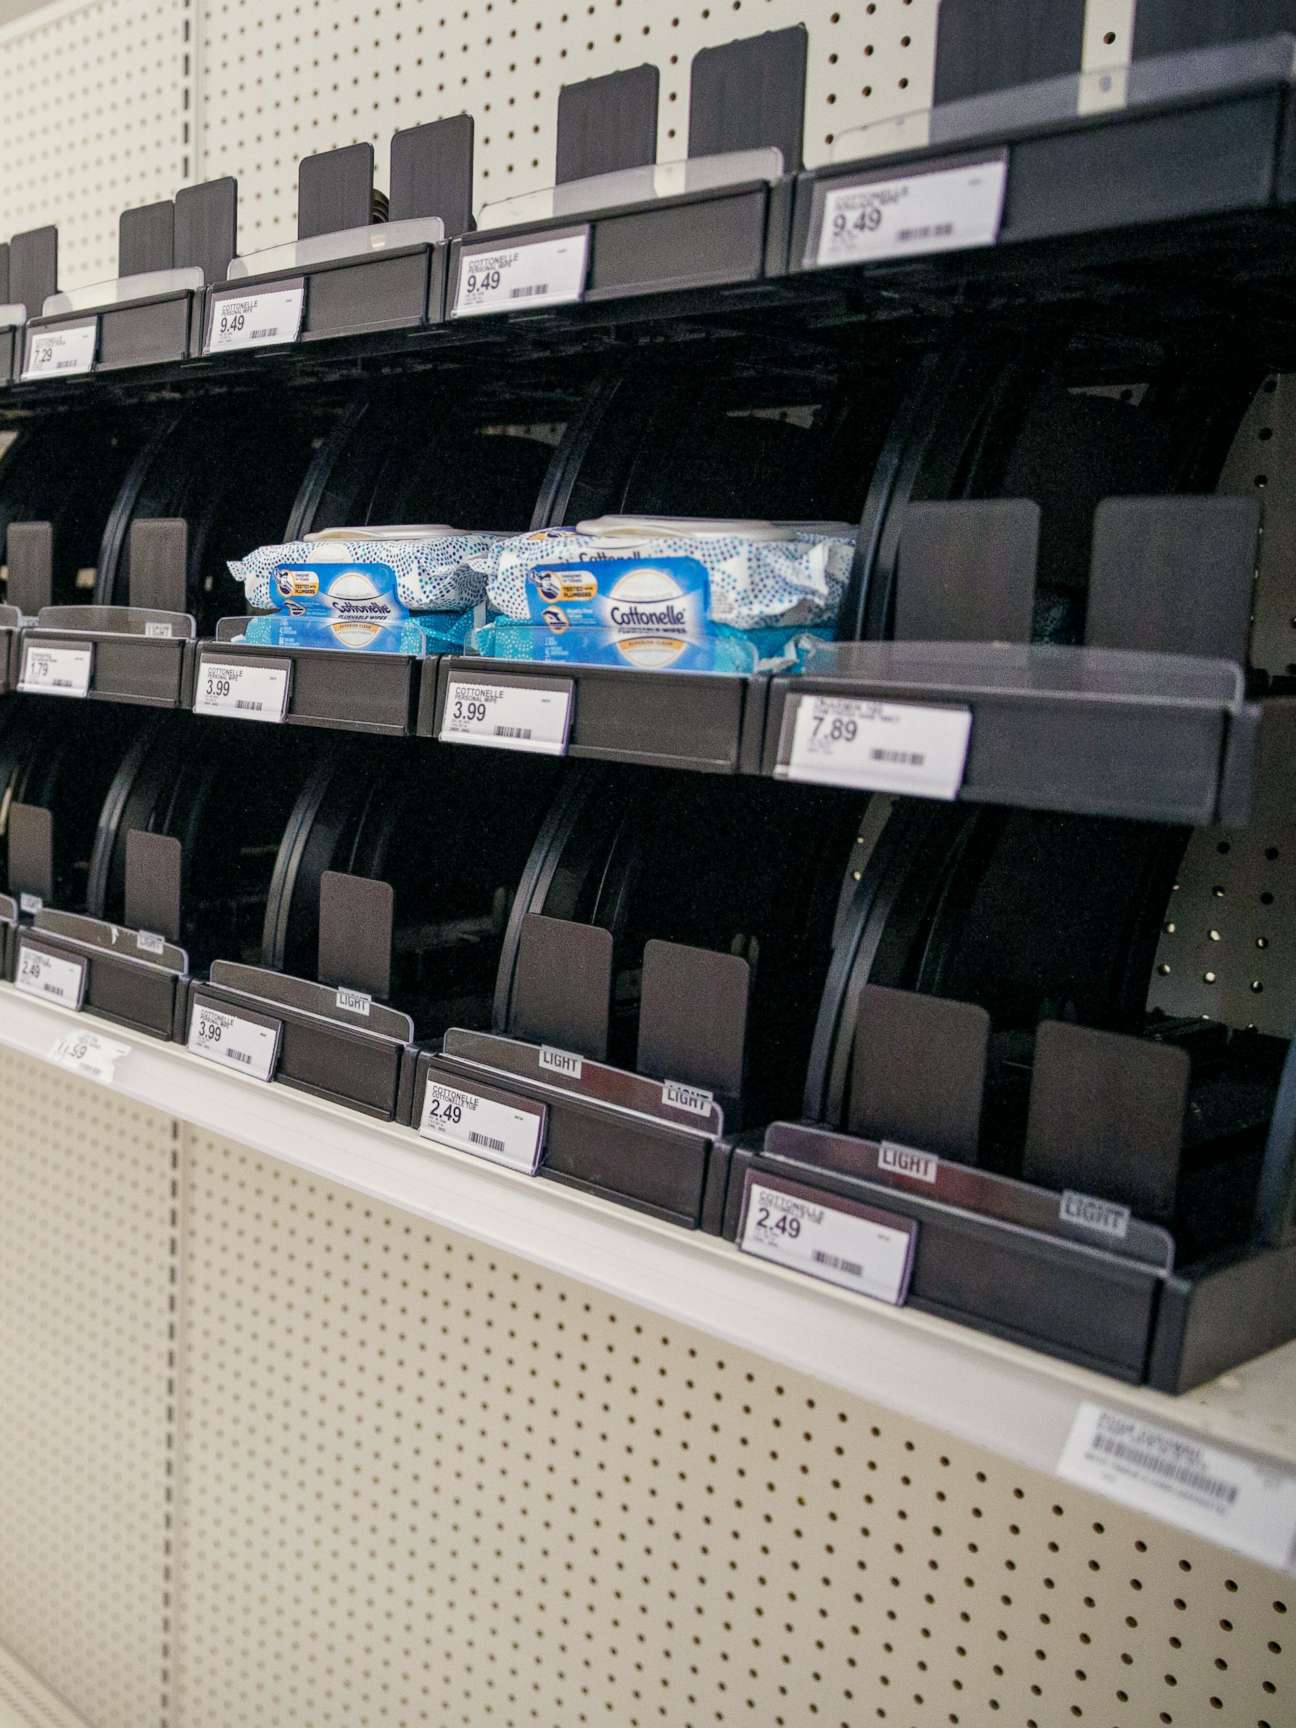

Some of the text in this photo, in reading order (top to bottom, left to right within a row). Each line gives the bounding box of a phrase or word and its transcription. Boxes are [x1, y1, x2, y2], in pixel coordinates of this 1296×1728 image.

[833, 207, 883, 237] 9.49
[468, 252, 520, 268] COTTONELLE
[466, 271, 501, 293] 9.49
[220, 315, 245, 333] 9.49
[332, 601, 391, 614] Cottonelle
[611, 605, 686, 625] Cottonelle
[206, 680, 230, 696] 3.99
[456, 687, 504, 698] COTTONELLE
[453, 701, 486, 721] 3.99
[813, 716, 858, 742] 7.89
[22, 961, 40, 978] 2.49
[340, 993, 369, 1012] LIGHT
[199, 1021, 222, 1041] 3.99
[543, 1051, 577, 1072] LIGHT
[432, 1085, 479, 1106] COTTONELLE
[667, 1085, 709, 1110] LIGHT
[430, 1099, 461, 1123] 2.49
[883, 1149, 930, 1176] LIGHT
[1065, 1195, 1126, 1229] LIGHT
[757, 1207, 801, 1238] 2.49
